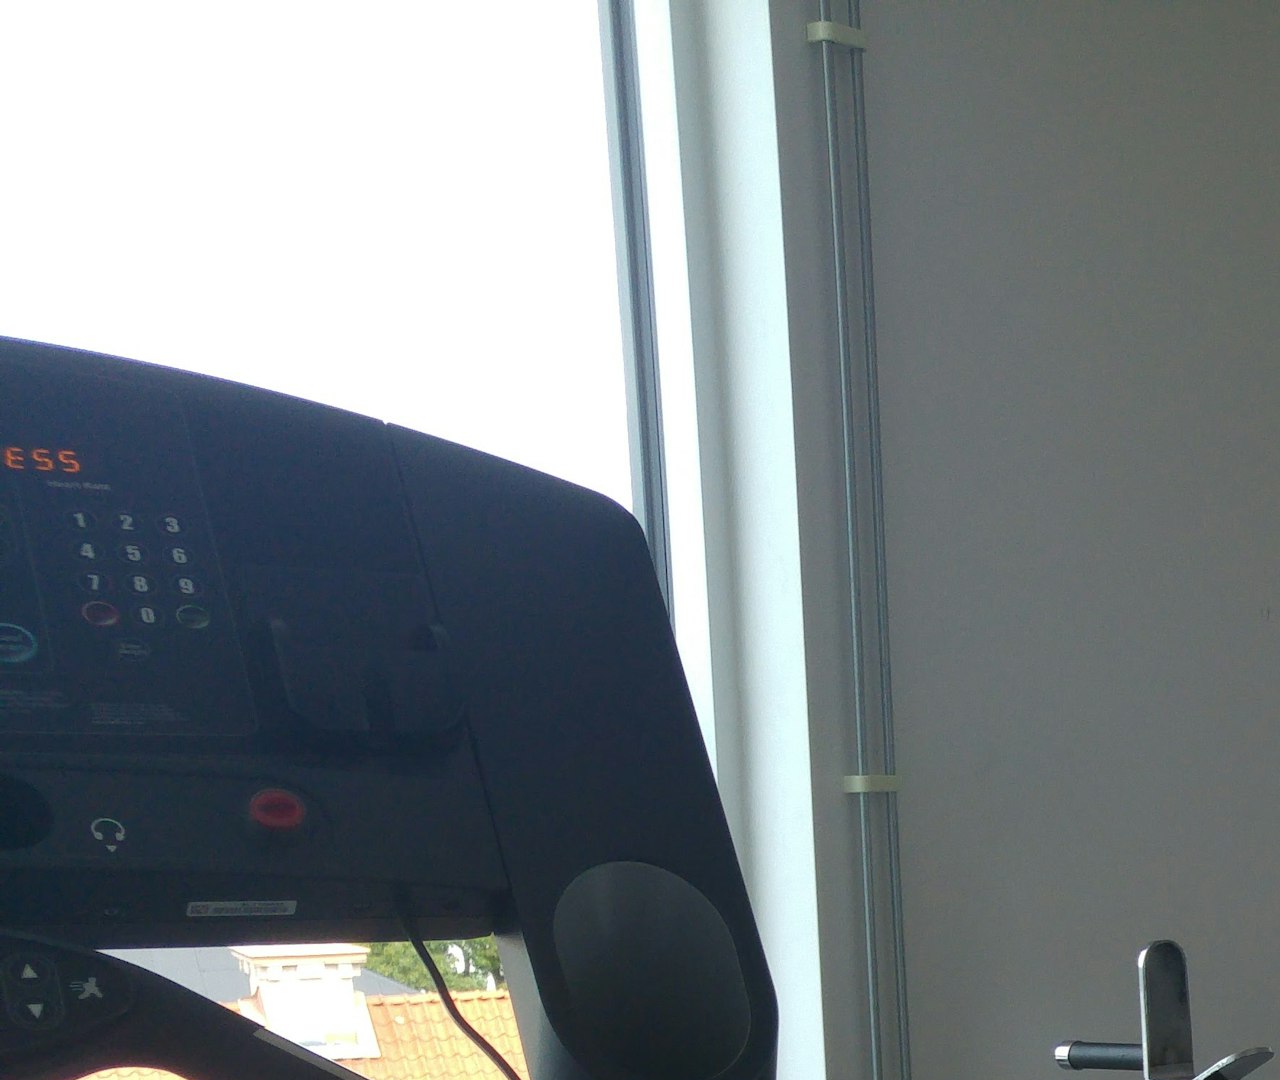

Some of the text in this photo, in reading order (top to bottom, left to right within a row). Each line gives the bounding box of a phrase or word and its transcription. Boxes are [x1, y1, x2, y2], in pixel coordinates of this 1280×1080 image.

[73, 512, 182, 533] 1 2 3
[80, 543, 188, 564] 4 5 6
[87, 574, 195, 594] 7 8 9
[140, 607, 156, 624] 0
